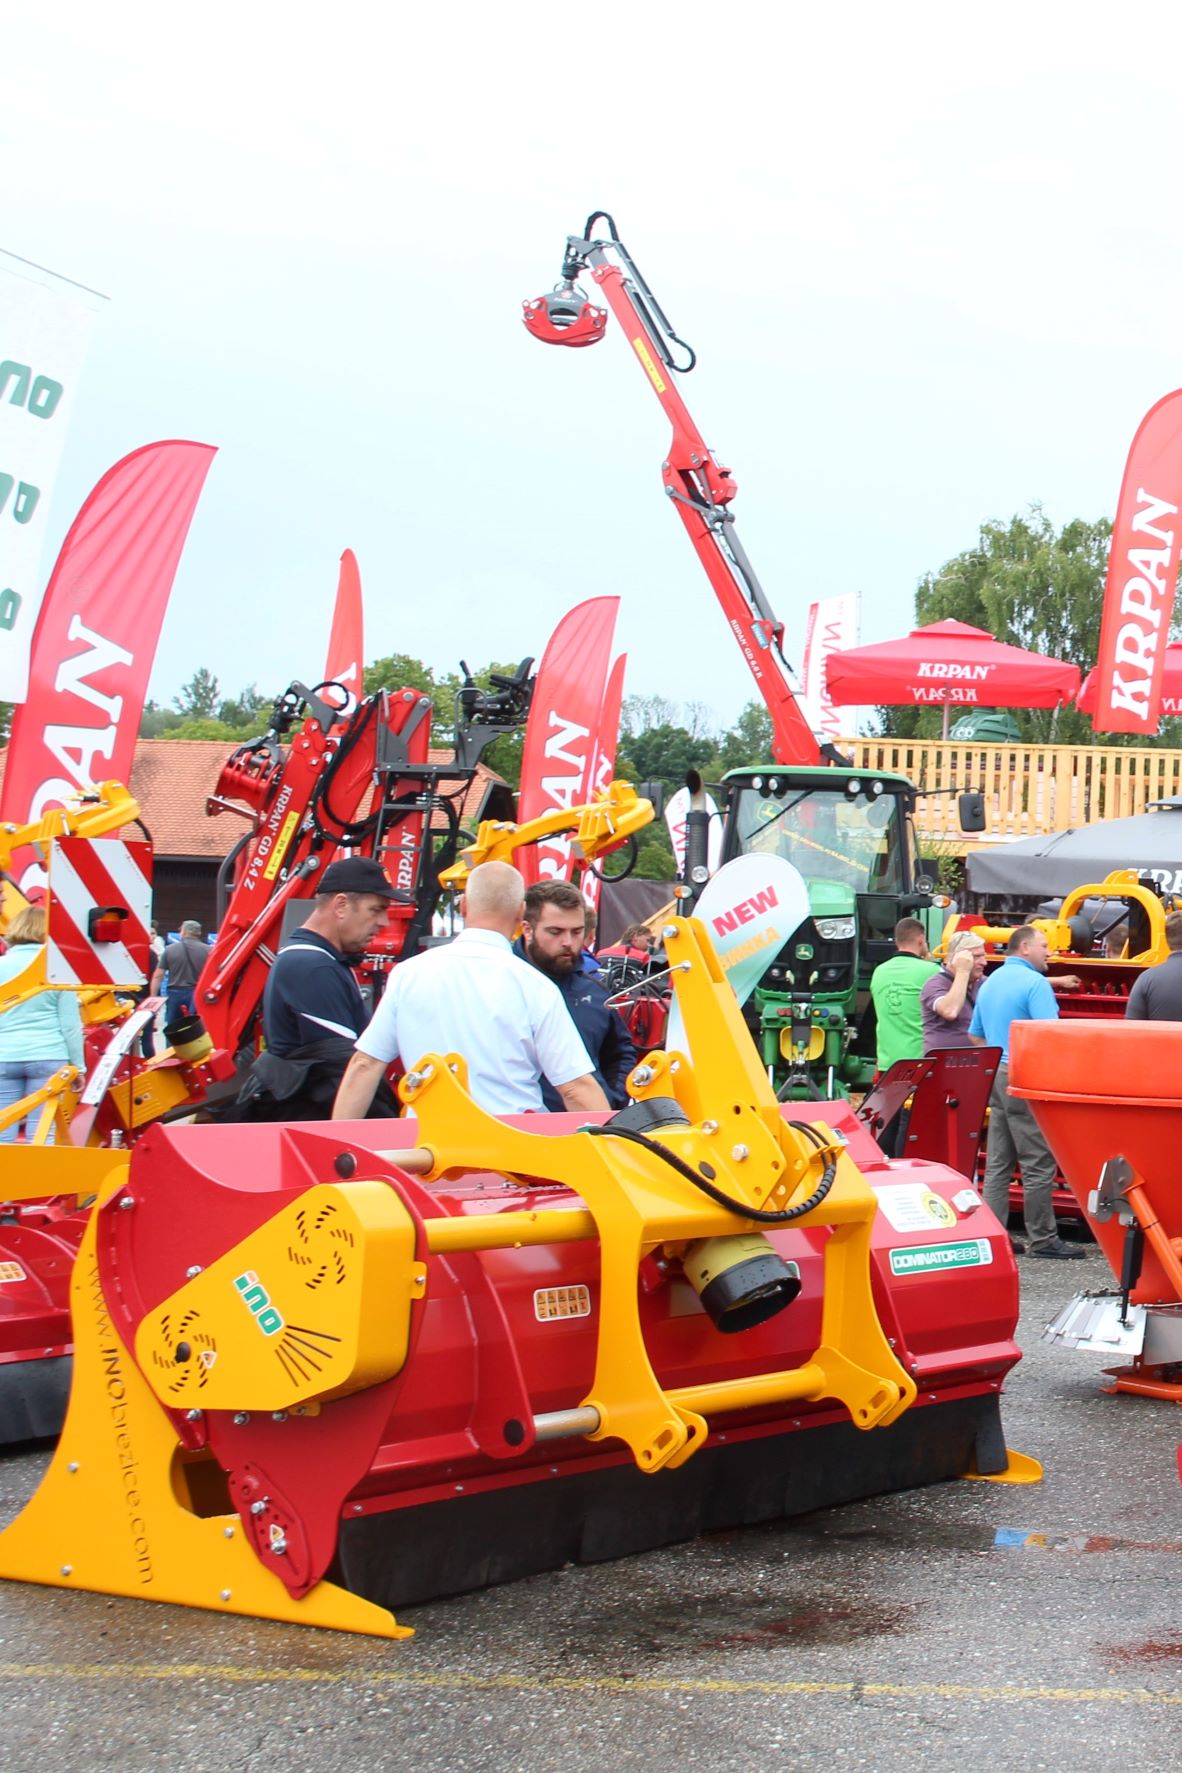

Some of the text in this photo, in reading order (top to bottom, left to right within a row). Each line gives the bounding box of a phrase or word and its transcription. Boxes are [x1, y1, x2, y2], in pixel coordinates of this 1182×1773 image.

[0, 359, 64, 419] no
[1110, 487, 1178, 721] KRPAN
[917, 662, 991, 680] KRPAN
[267, 784, 294, 831] KRPAN
[256, 834, 273, 857] GD
[243, 879, 254, 891] Z
[712, 885, 780, 938] NEW
